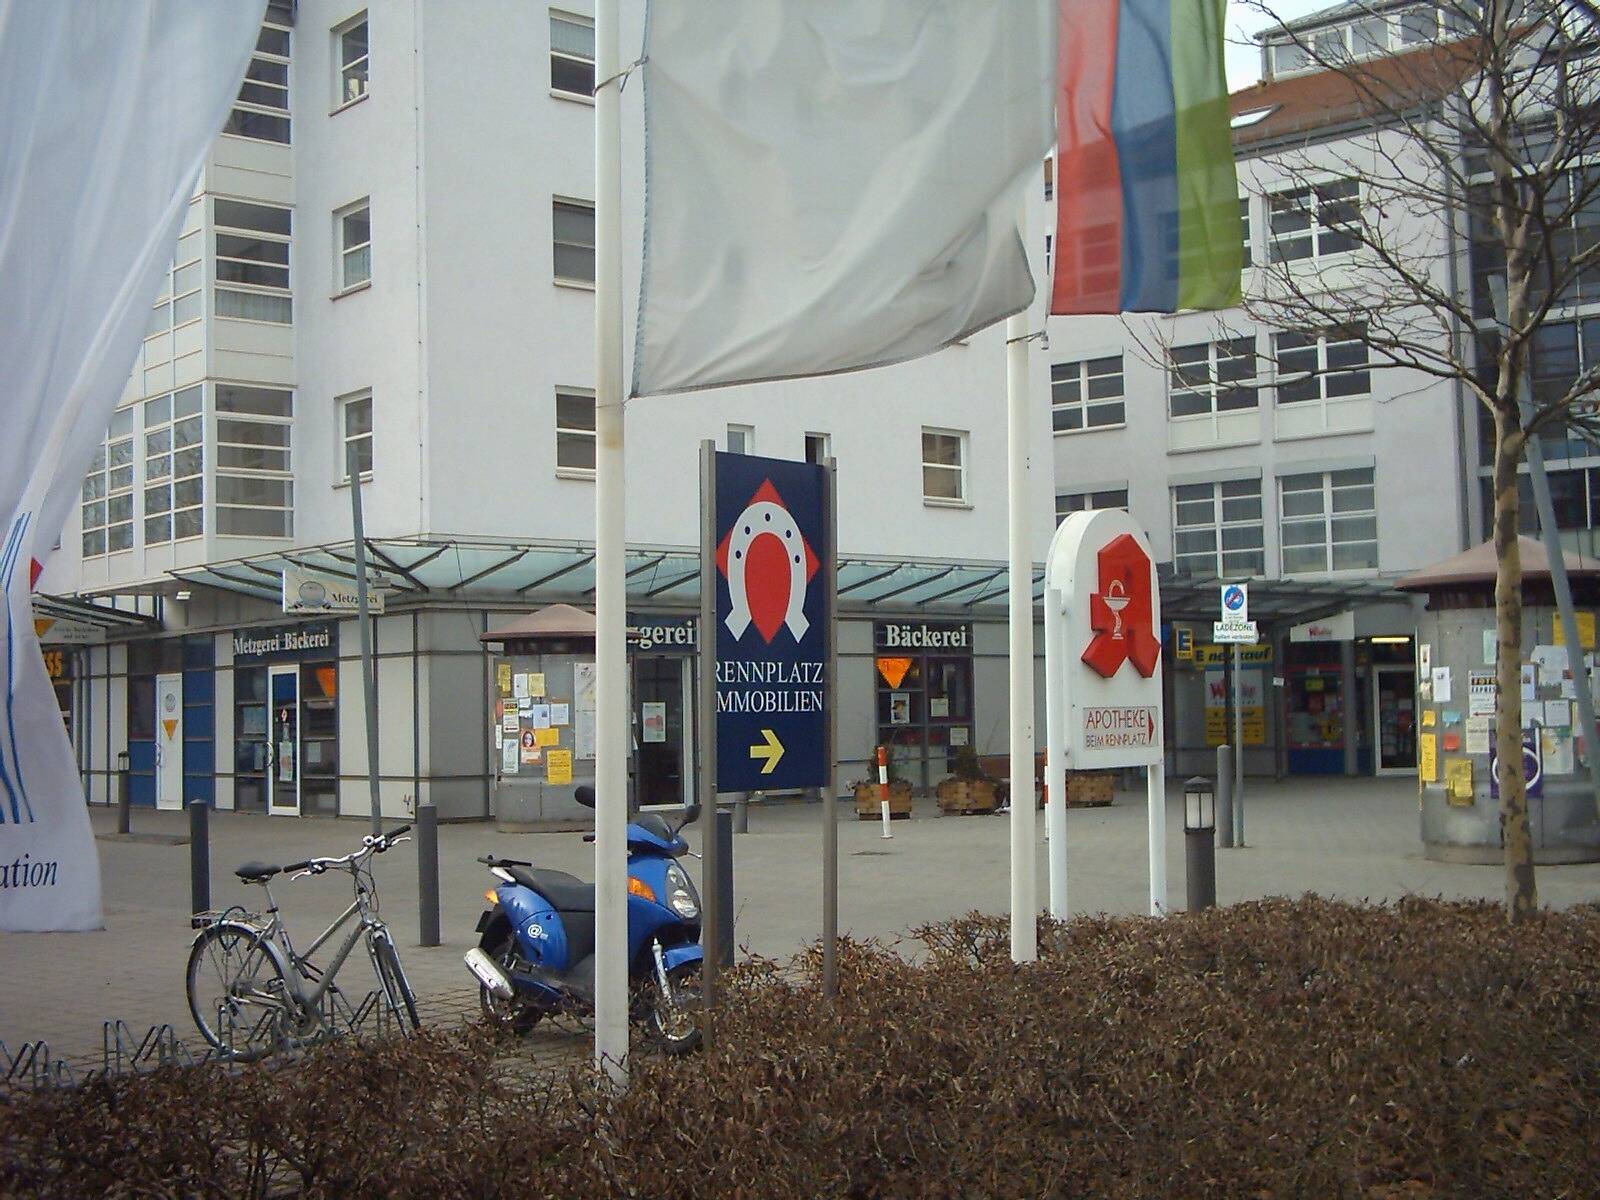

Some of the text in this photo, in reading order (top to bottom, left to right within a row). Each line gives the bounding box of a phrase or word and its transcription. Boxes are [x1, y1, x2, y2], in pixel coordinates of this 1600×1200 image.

[234, 629, 329, 656] Metzgerei Bäckerei
[885, 624, 967, 647] Bäckerei
[715, 661, 823, 683] RENNPLATZ
[716, 690, 823, 712] MMOBILIEN
[1086, 709, 1146, 729] APOTHEKE
